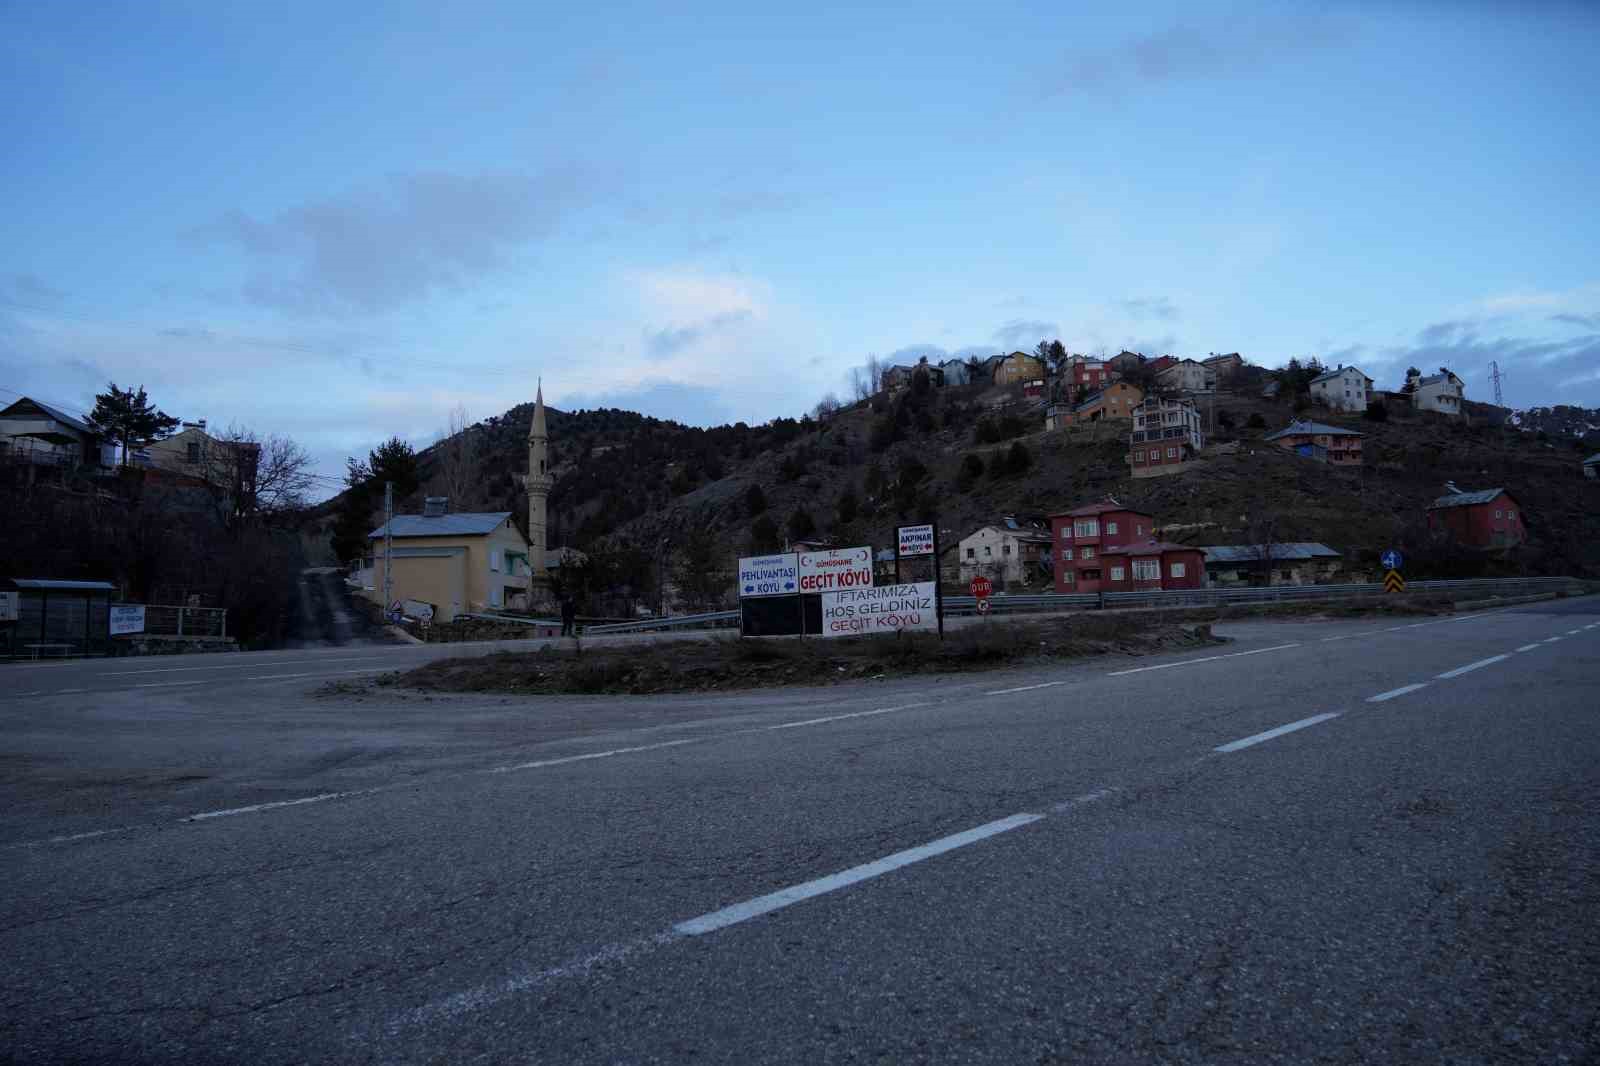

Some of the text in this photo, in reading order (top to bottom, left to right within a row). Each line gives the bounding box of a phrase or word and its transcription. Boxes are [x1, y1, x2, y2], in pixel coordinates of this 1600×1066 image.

[901, 533, 931, 543] AKPINAR
[741, 567, 796, 581] PEHLİVANTAŞI
[801, 567, 870, 590] GEÇİT KÖYÜ
[971, 582, 989, 592] DUR
[825, 597, 931, 619] HOŞ GELDİNİZ
[830, 610, 920, 632] GEÇİT KÖYÜ
